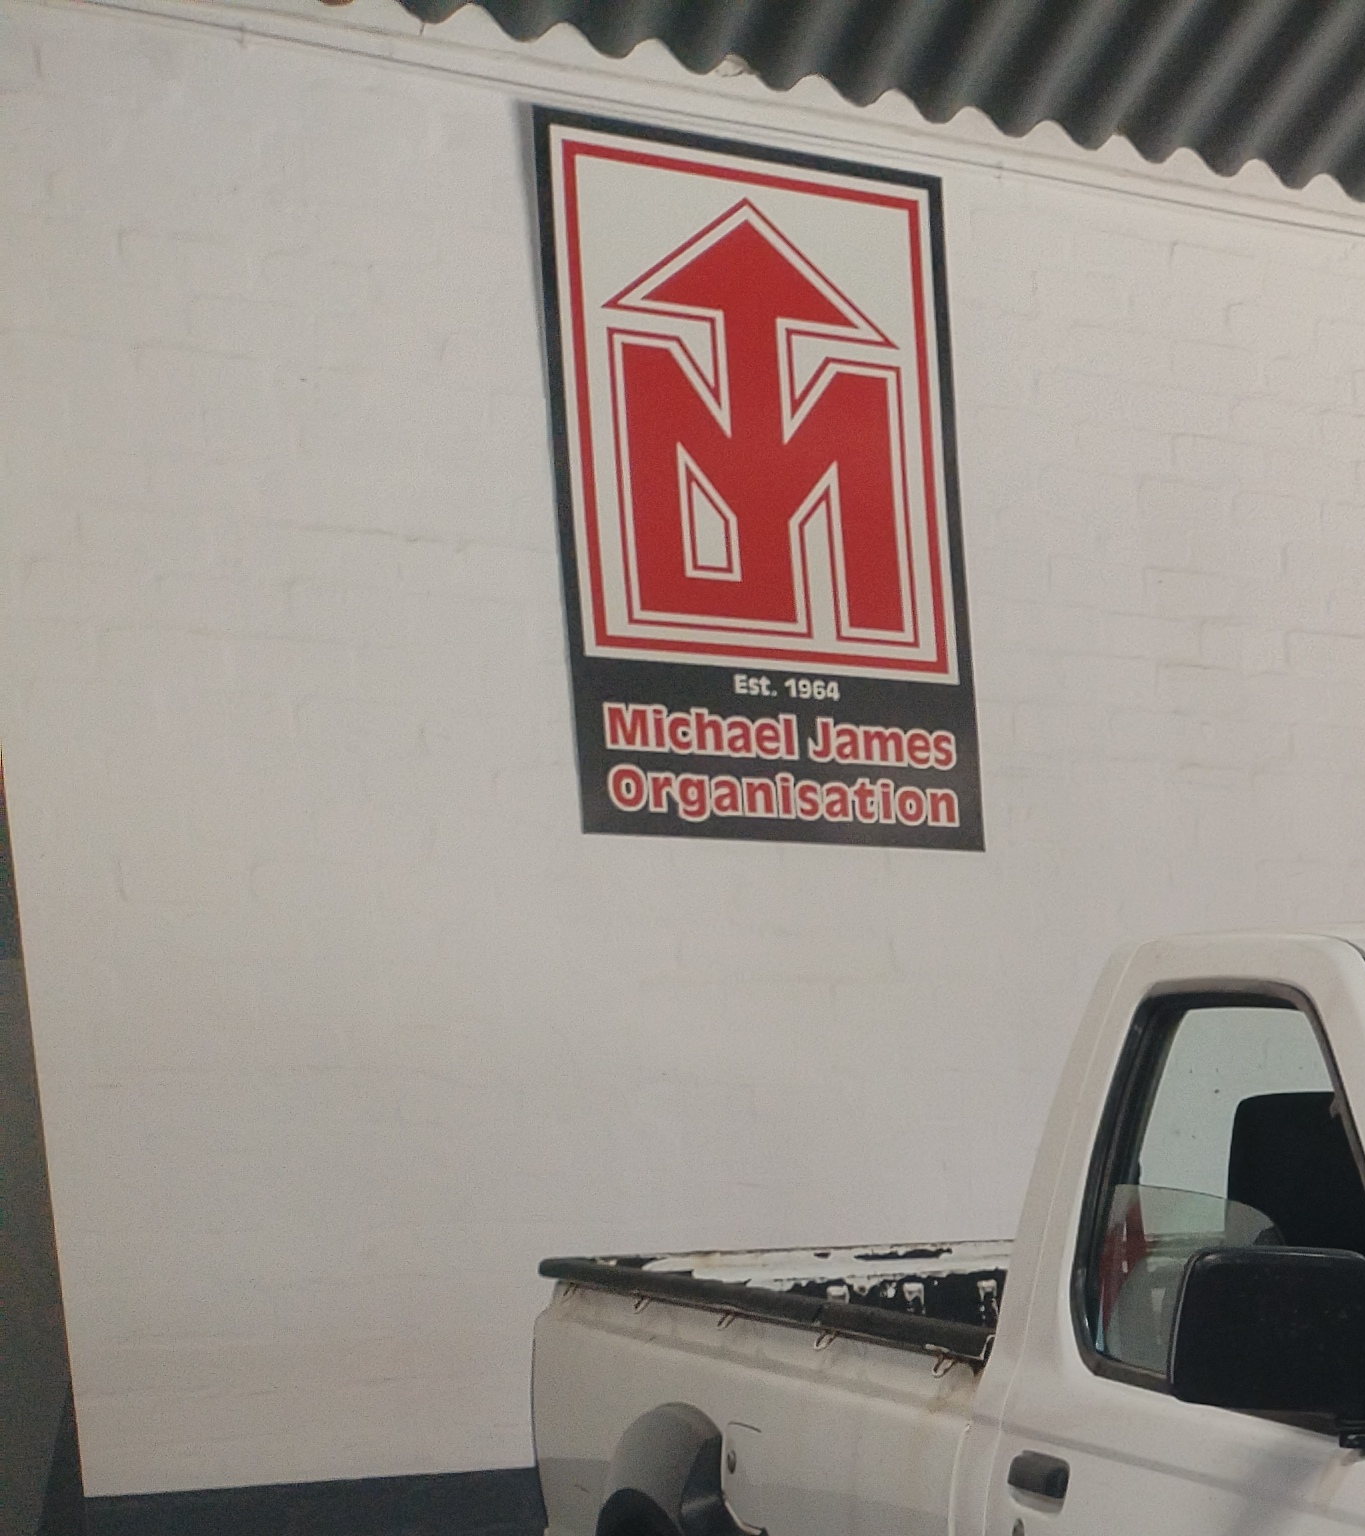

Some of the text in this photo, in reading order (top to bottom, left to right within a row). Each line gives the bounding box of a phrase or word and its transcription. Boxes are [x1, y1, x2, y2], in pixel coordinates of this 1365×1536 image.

[733, 673, 840, 700] Est. 1964
[603, 702, 957, 770] Michael James
[607, 763, 960, 827] Organisation
